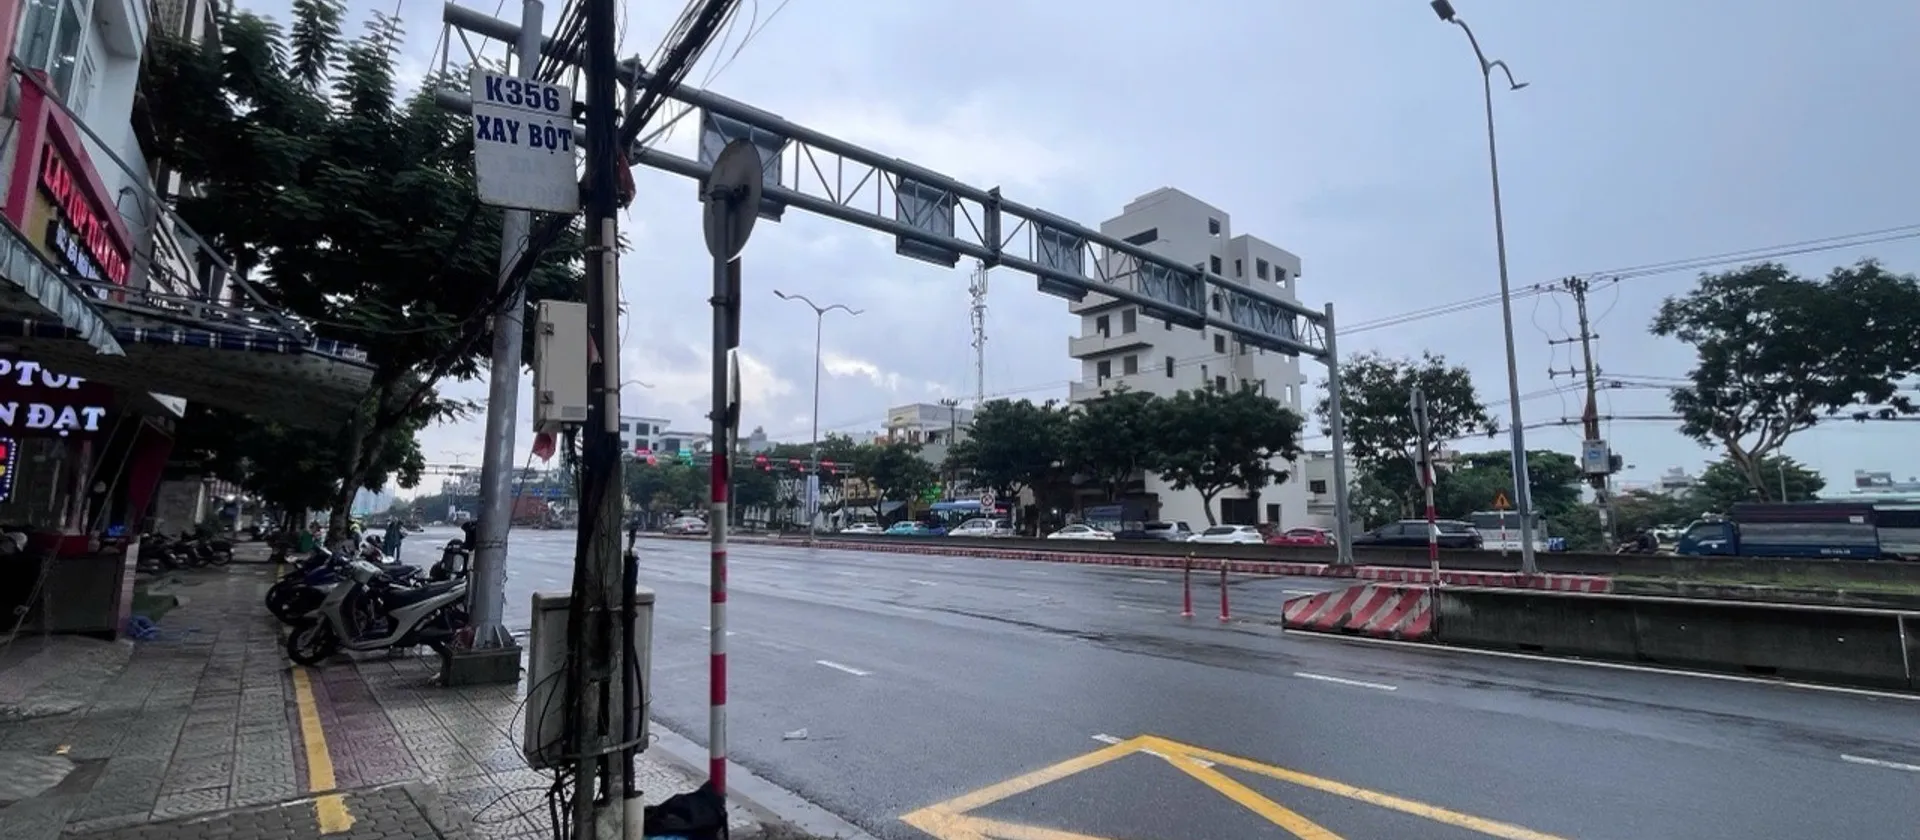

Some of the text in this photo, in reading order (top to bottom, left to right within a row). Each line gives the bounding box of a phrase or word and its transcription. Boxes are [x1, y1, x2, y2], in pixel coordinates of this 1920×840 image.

[486, 75, 560, 113] K356
[476, 114, 572, 154] XAY BỘT
[44, 143, 87, 234] LAPTOP
[25, 403, 106, 437] ĐẠT
